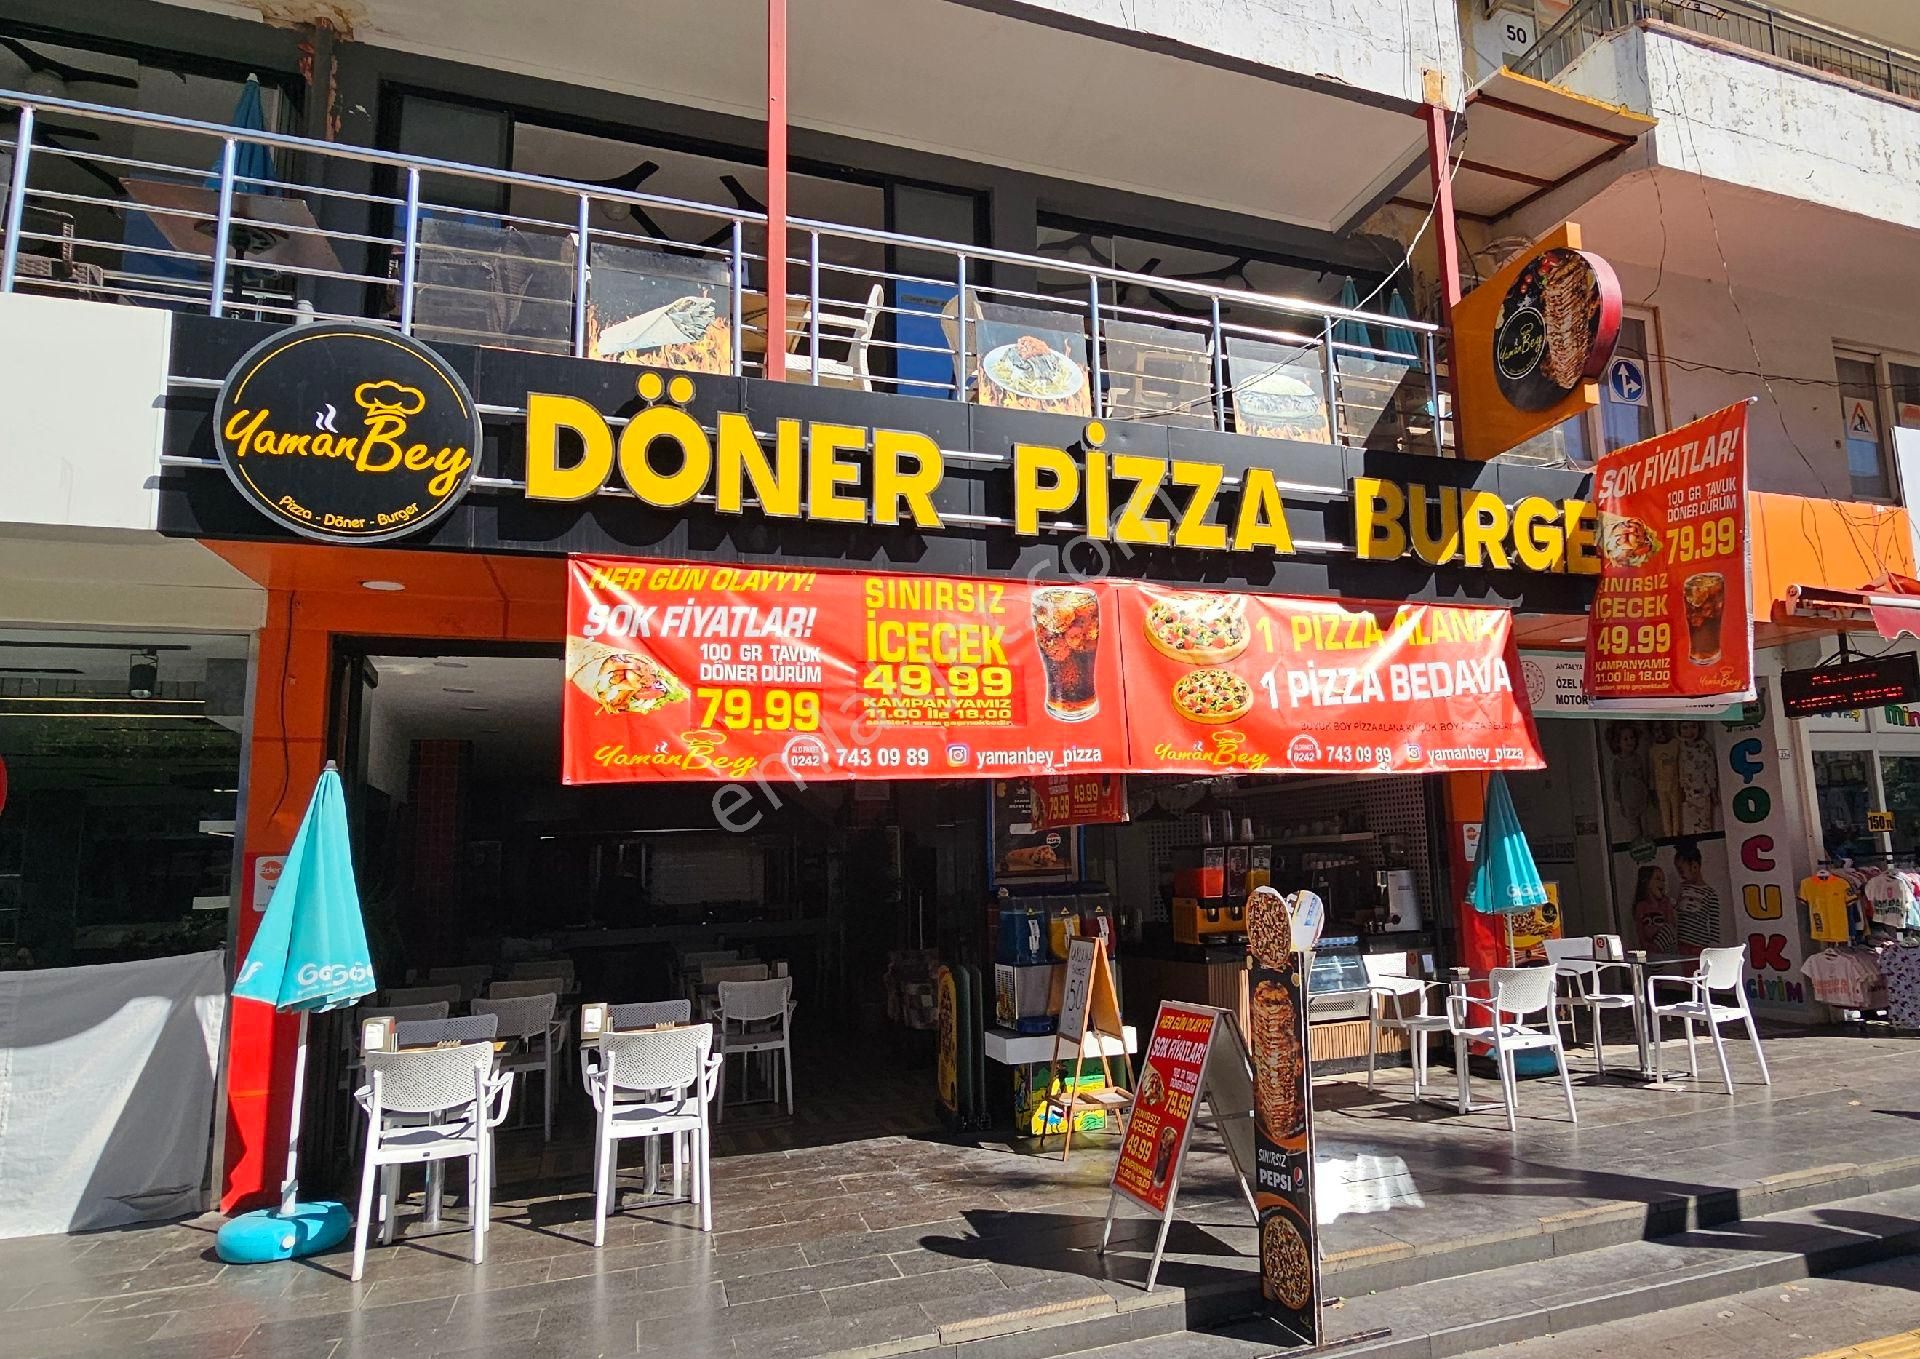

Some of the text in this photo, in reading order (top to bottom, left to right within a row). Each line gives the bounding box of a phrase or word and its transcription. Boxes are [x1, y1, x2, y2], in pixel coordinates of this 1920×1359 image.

[1506, 24, 1527, 44] 50
[1641, 427, 1741, 491] FİYATLAR!
[525, 371, 1601, 574] DÖNER PİZZA BURGE
[1667, 490, 1685, 506] 100
[1706, 477, 1737, 497] TAVUK
[278, 495, 311, 520] Pizza
[323, 512, 365, 528] Döner
[376, 502, 419, 527] Burger
[1666, 517, 1735, 565] 79.99
[650, 564, 707, 592] GÜN
[711, 569, 817, 593] OLAYYY!
[1599, 572, 1669, 594] INIRSIZ
[582, 598, 817, 643] ŞOK FİYATLAR!
[1256, 615, 1275, 653] 1
[1597, 623, 1671, 655] 49.99
[700, 644, 732, 662] 100
[739, 645, 763, 662] GR
[1595, 657, 1671, 671] KAMPANYAMIZ
[761, 663, 822, 684] DÜRÜM
[863, 664, 1013, 698] 49.99
[1260, 670, 1279, 709] 1
[1389, 656, 1514, 703] BEDAVA
[1556, 677, 1579, 689] ÖZEL
[1595, 671, 1621, 683] 11.00
[1639, 670, 1671, 682] 18.00
[863, 697, 1012, 709] KAMPANYAMIZ
[1556, 694, 1593, 706] MOTOR
[954, 708, 1012, 719] 18.00
[791, 748, 929, 767] 0242 743 09 89
[976, 744, 1103, 770] yamanbey_pizza
[1325, 745, 1353, 763] 743
[1355, 746, 1372, 763] 09
[1375, 746, 1392, 763] 89
[1427, 745, 1524, 763] yamanbey_pizza
[1868, 815, 1885, 831] 150
[1729, 738, 1791, 971] ÇOCUK
[1164, 1090, 1193, 1120] 79.99
[1126, 1134, 1153, 1162] 49.99
[1259, 1168, 1292, 1192] PEPSI
